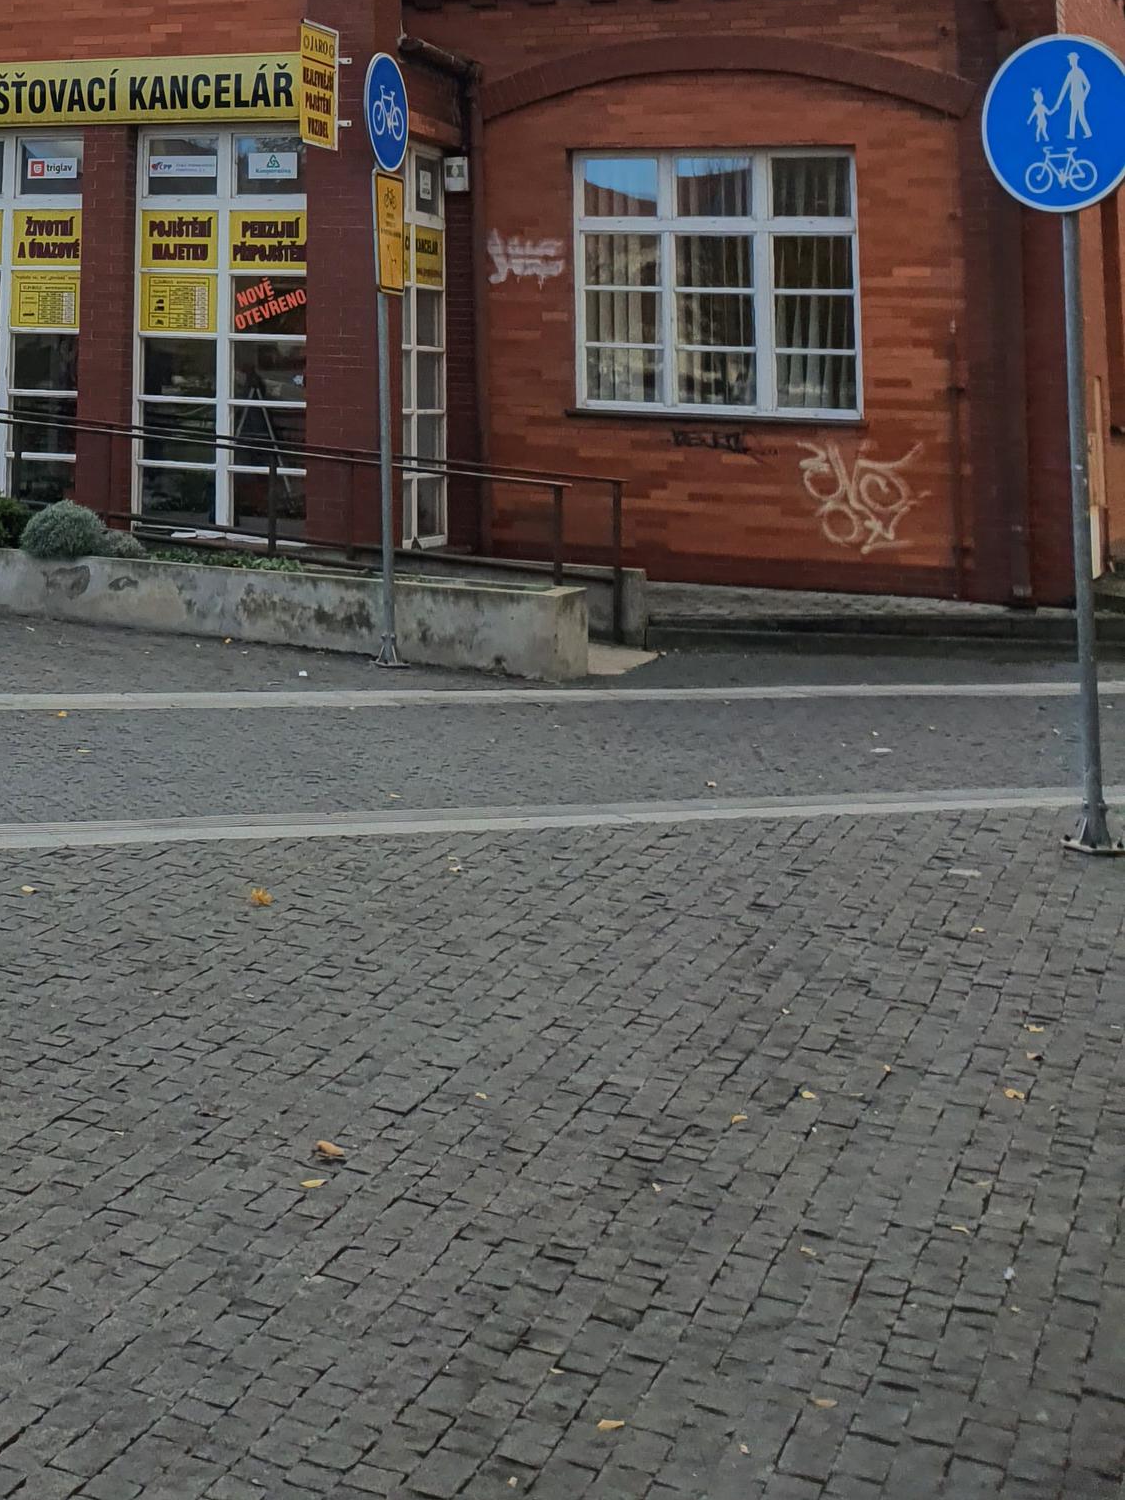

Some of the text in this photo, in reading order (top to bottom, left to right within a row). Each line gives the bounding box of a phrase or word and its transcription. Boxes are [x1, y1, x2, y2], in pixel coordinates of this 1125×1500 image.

[309, 35, 328, 56] JARO
[129, 62, 294, 112] KANCELÁŘ
[307, 116, 329, 139] VOZIDEL
[46, 162, 73, 174] triglav
[25, 216, 75, 237] ŽIVOTNÍ
[149, 216, 213, 238] POJIŠTĚNÍ
[242, 217, 301, 239] PENZIJNÍ
[17, 241, 26, 259] A
[152, 243, 209, 261] MAJETKU
[236, 276, 275, 308] NOVĚ
[234, 287, 307, 330] OTEVŘENO
